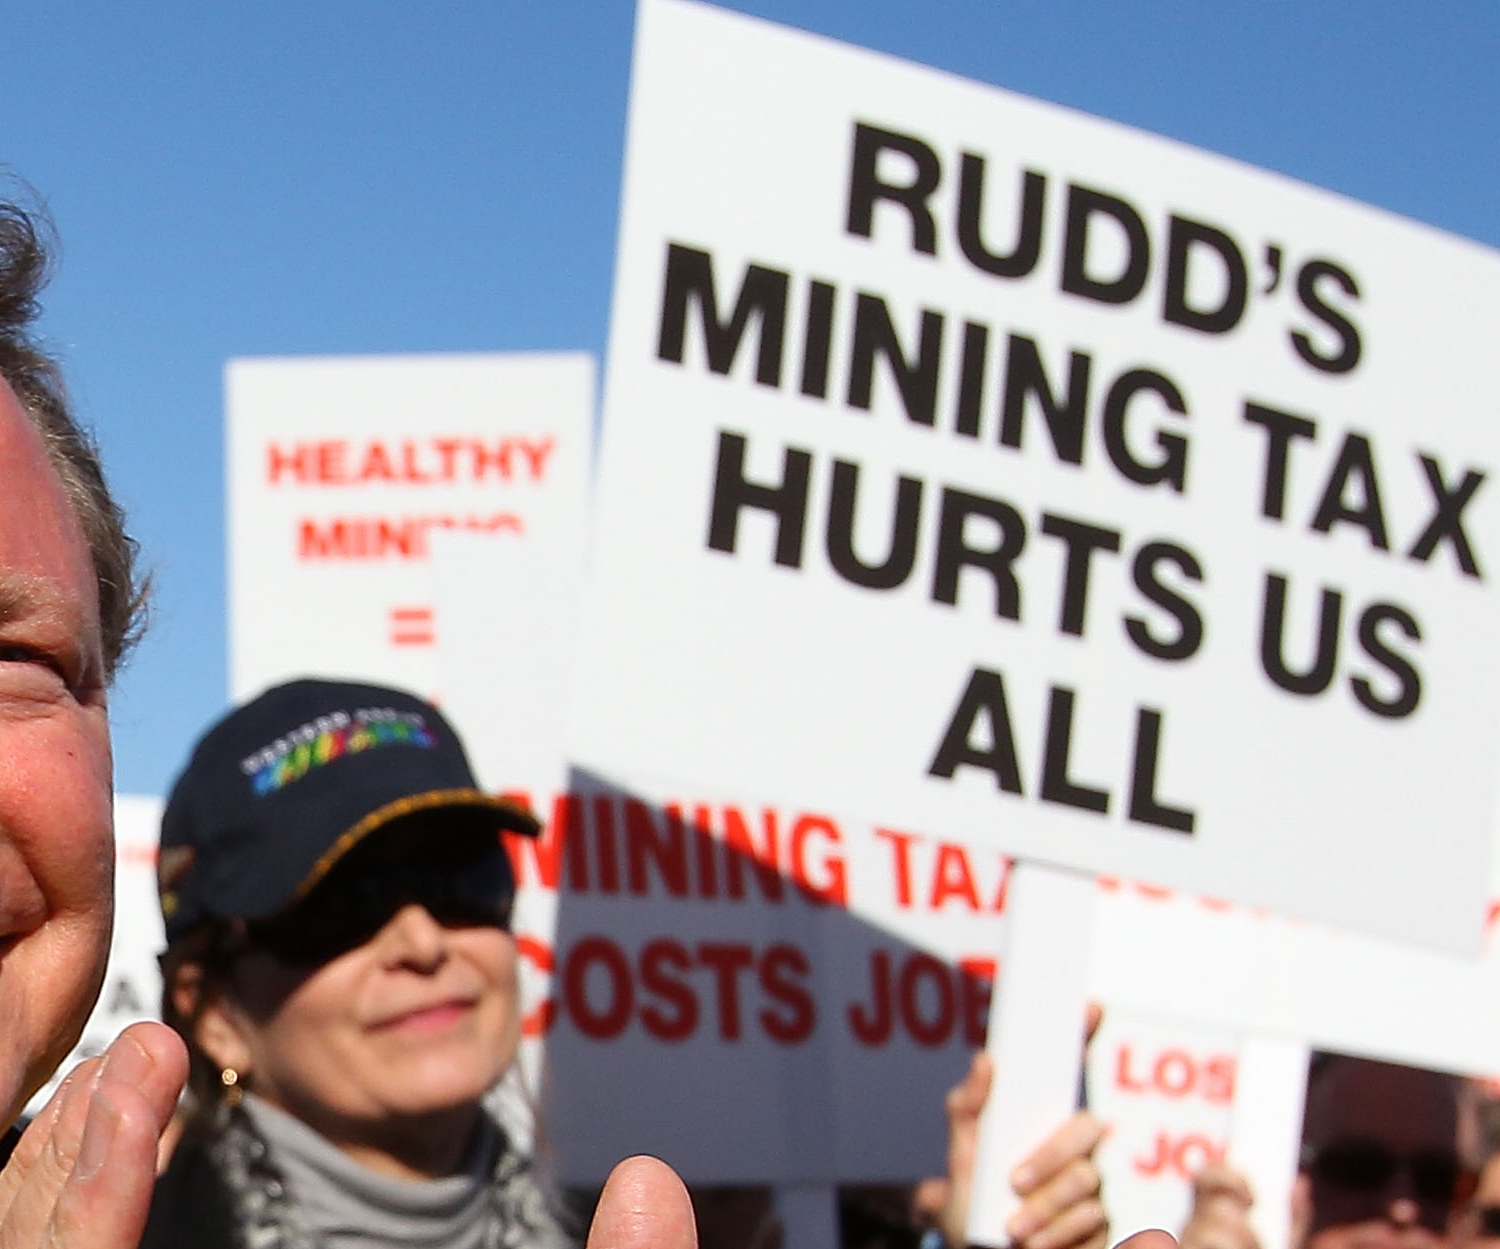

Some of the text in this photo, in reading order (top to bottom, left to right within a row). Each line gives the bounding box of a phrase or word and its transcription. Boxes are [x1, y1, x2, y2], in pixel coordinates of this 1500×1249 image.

[846, 121, 1363, 375] RUDD'S
[266, 437, 555, 487] HEALTHY
[657, 242, 1487, 582] MINING TAX
[296, 514, 523, 560] MIN
[707, 431, 1422, 720] HURTS US
[928, 668, 1195, 835] ALL
[500, 788, 853, 911] MINING
[515, 931, 816, 1043] COSTS
